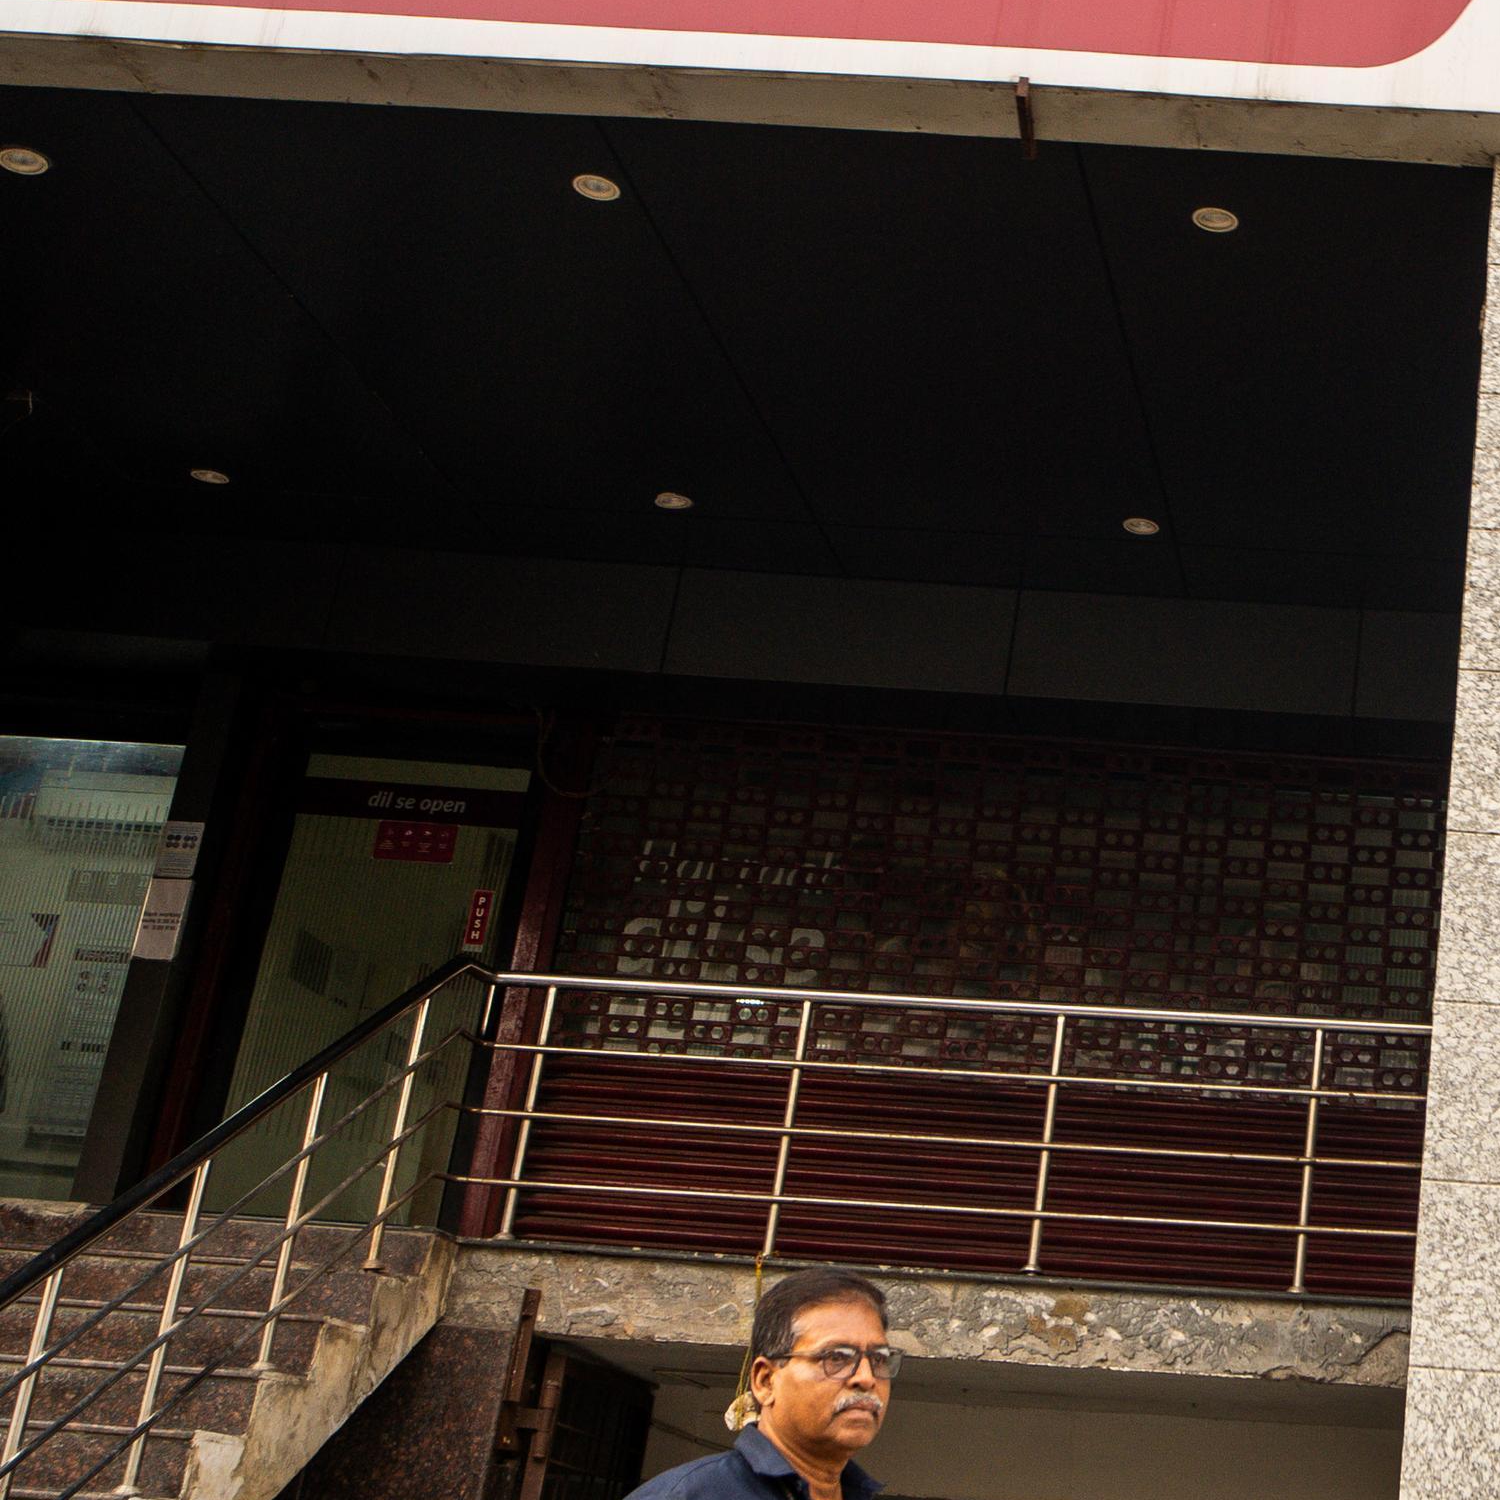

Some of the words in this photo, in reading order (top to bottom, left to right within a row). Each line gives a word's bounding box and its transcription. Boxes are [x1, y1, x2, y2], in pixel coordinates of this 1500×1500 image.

[367, 790, 393, 809] dil
[394, 795, 417, 809] se
[419, 798, 467, 814] open
[471, 896, 487, 941] PUSH
